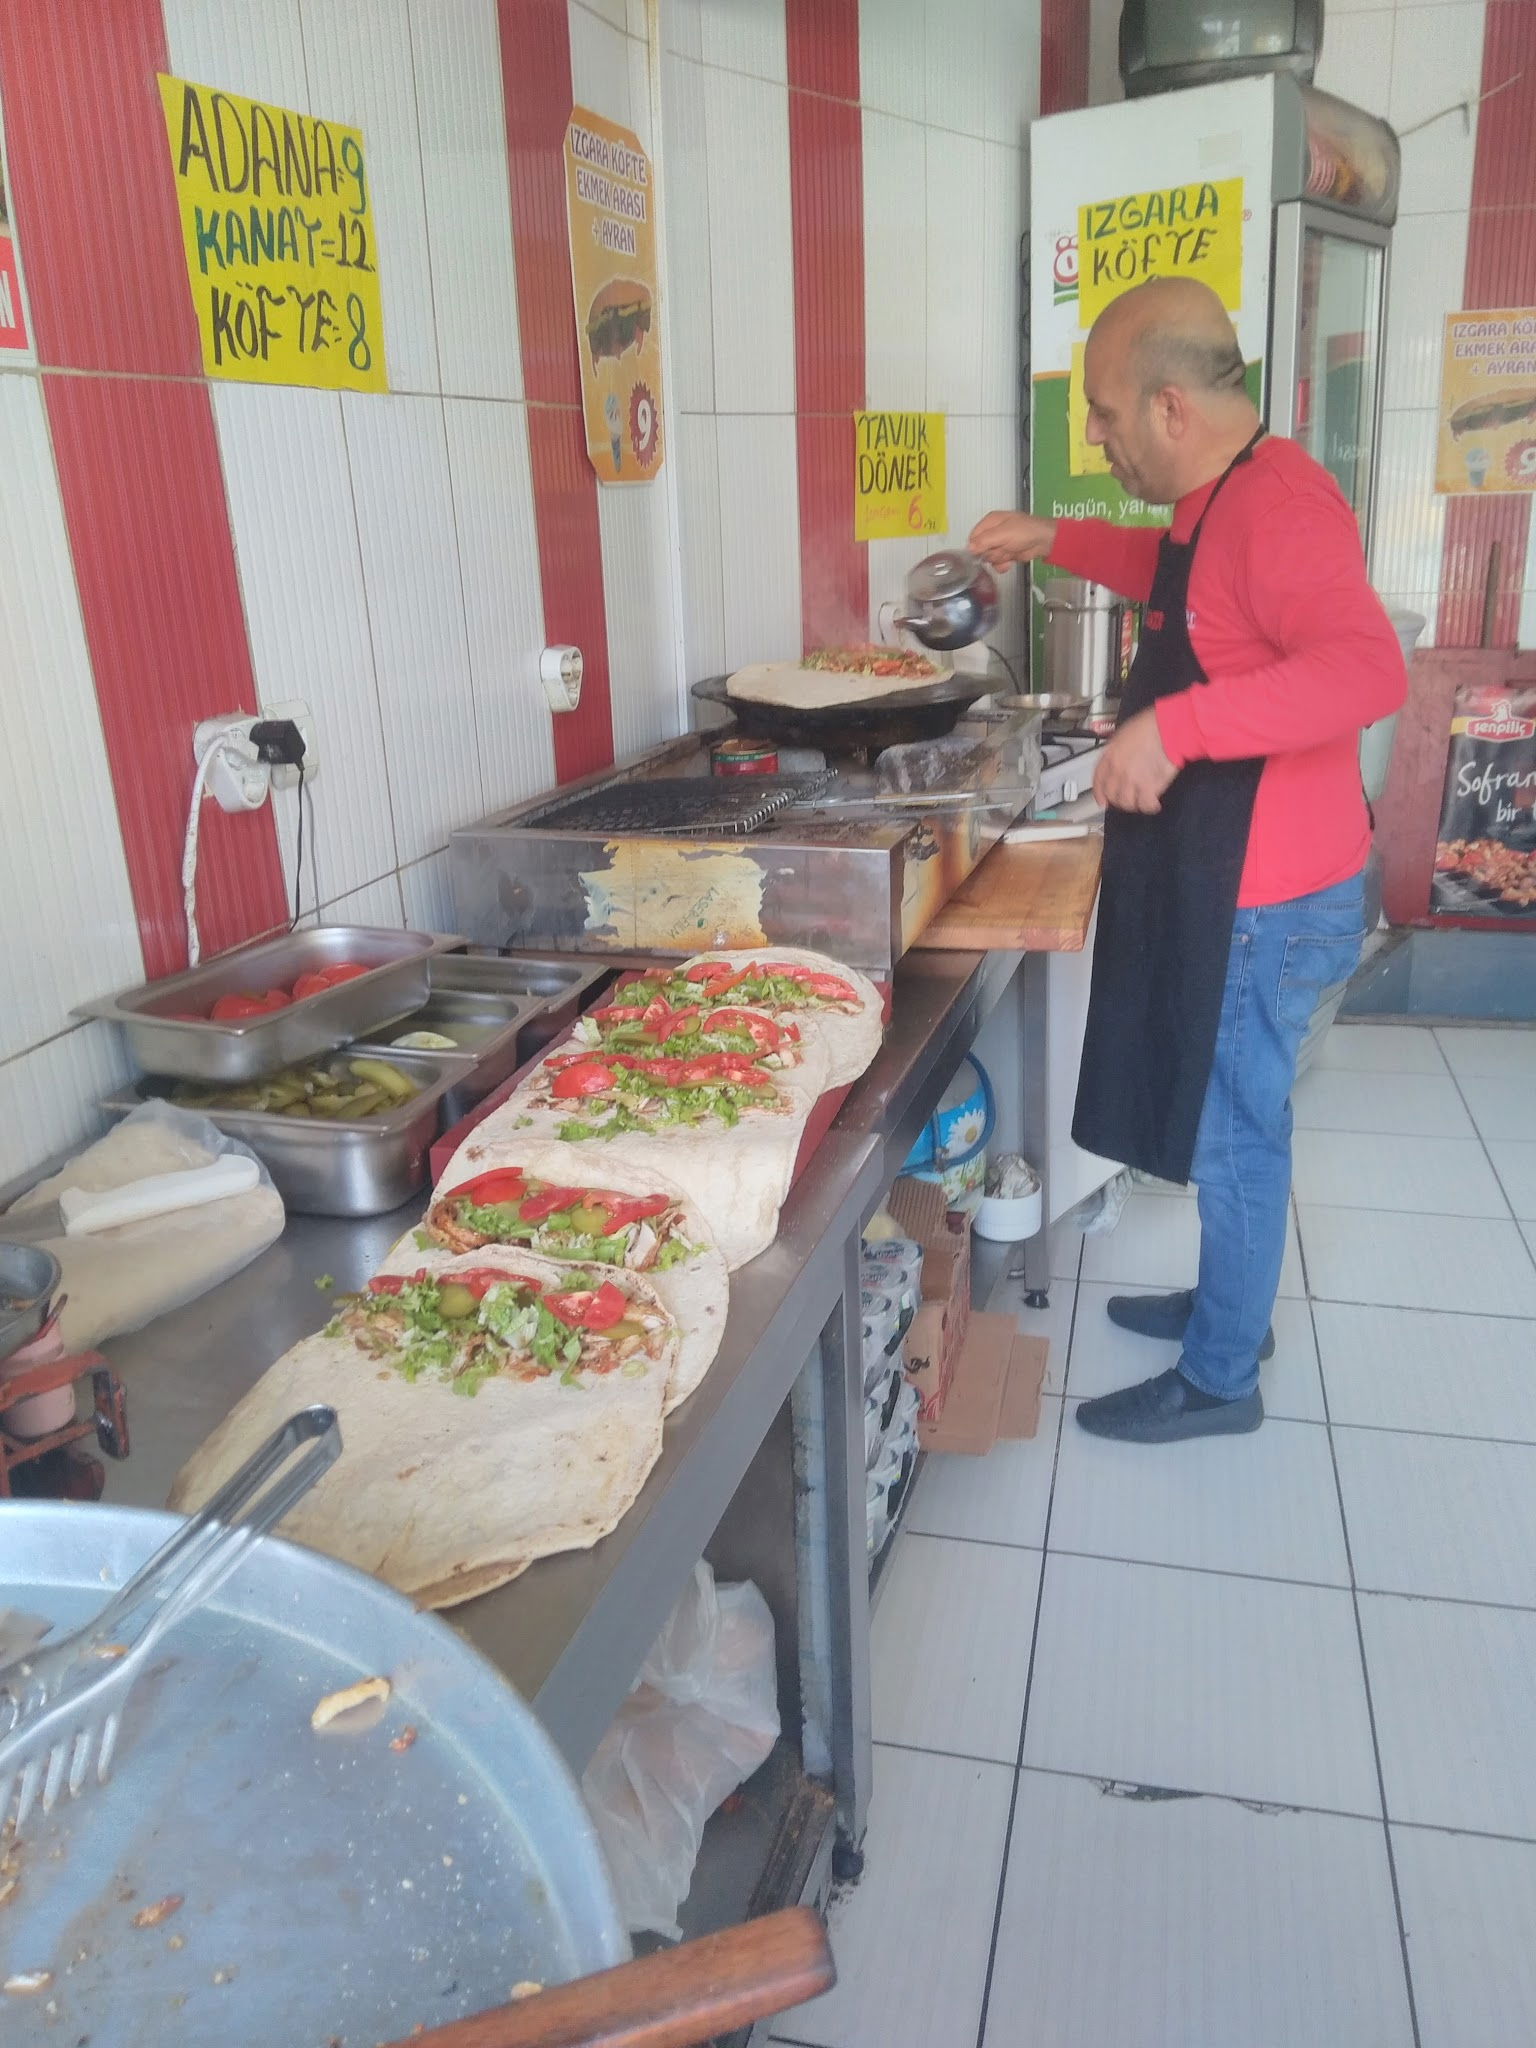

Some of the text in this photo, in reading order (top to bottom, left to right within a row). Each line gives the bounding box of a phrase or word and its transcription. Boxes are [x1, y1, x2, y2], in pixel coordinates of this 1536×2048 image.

[570, 126, 647, 183] IZGARA KÖFTE
[576, 170, 645, 219] EKMEK ARASI
[1086, 183, 1219, 241] IZGARA
[602, 220, 635, 253] AYRAN
[1093, 227, 1218, 285] KÖFTE
[1454, 318, 1536, 338] IZGARA KÖ
[1455, 342, 1505, 358] EKMEK
[1487, 360, 1536, 375] AYRAN
[637, 399, 652, 450] 9
[858, 413, 930, 450] TAVUK
[859, 451, 931, 494] DÖNER
[1518, 447, 1536, 475] 9
[1053, 498, 1112, 521] bugün,
[1496, 799, 1522, 822] bir
